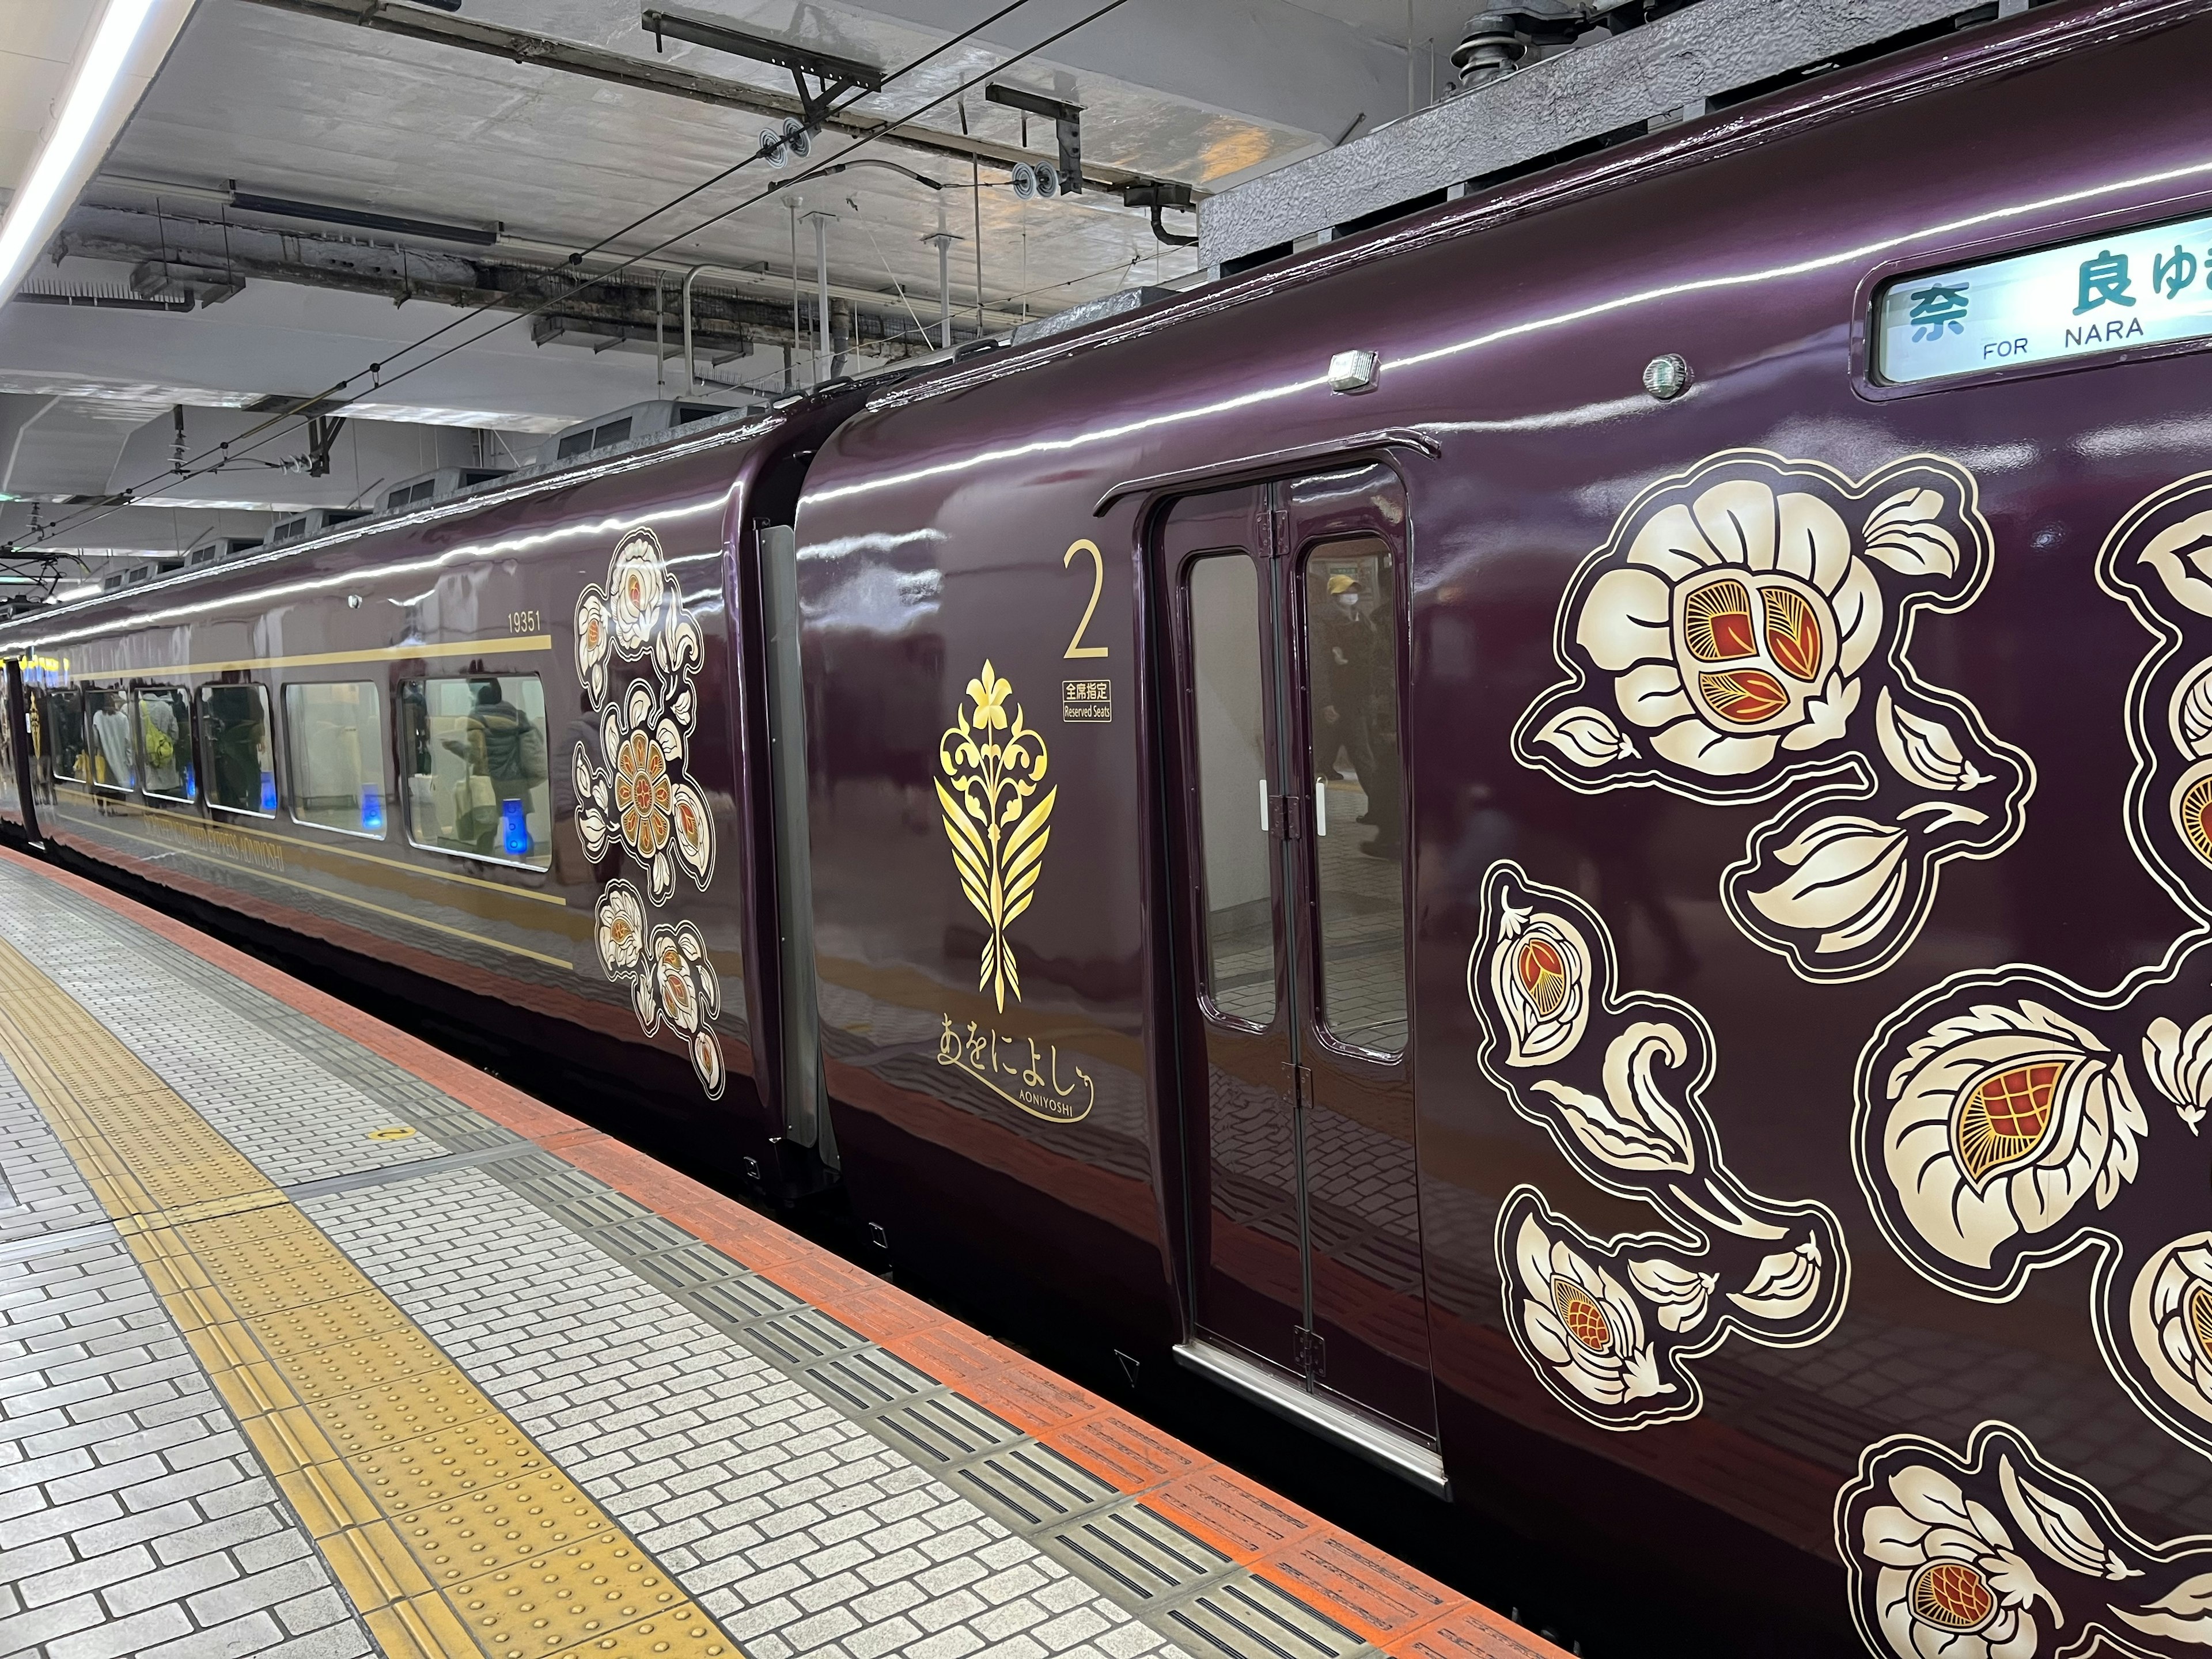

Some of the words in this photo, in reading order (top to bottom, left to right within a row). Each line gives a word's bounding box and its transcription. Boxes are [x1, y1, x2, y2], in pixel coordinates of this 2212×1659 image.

[1909, 244, 2212, 343] 奈良ゆ
[1983, 338, 2028, 360] FOR
[2065, 317, 2144, 348] NARA
[1063, 539, 1109, 659] 2
[508, 610, 540, 633] 19351
[1065, 704, 1092, 718] Reserved
[1093, 705, 1110, 718] Seats
[1066, 683, 1107, 700] 全席指定
[207, 830, 240, 859] EXPRESS
[240, 837, 285, 872] AONIYOSHI
[937, 1012, 1076, 1097] あをによし
[1019, 1089, 1073, 1118] AONIYOSHI
